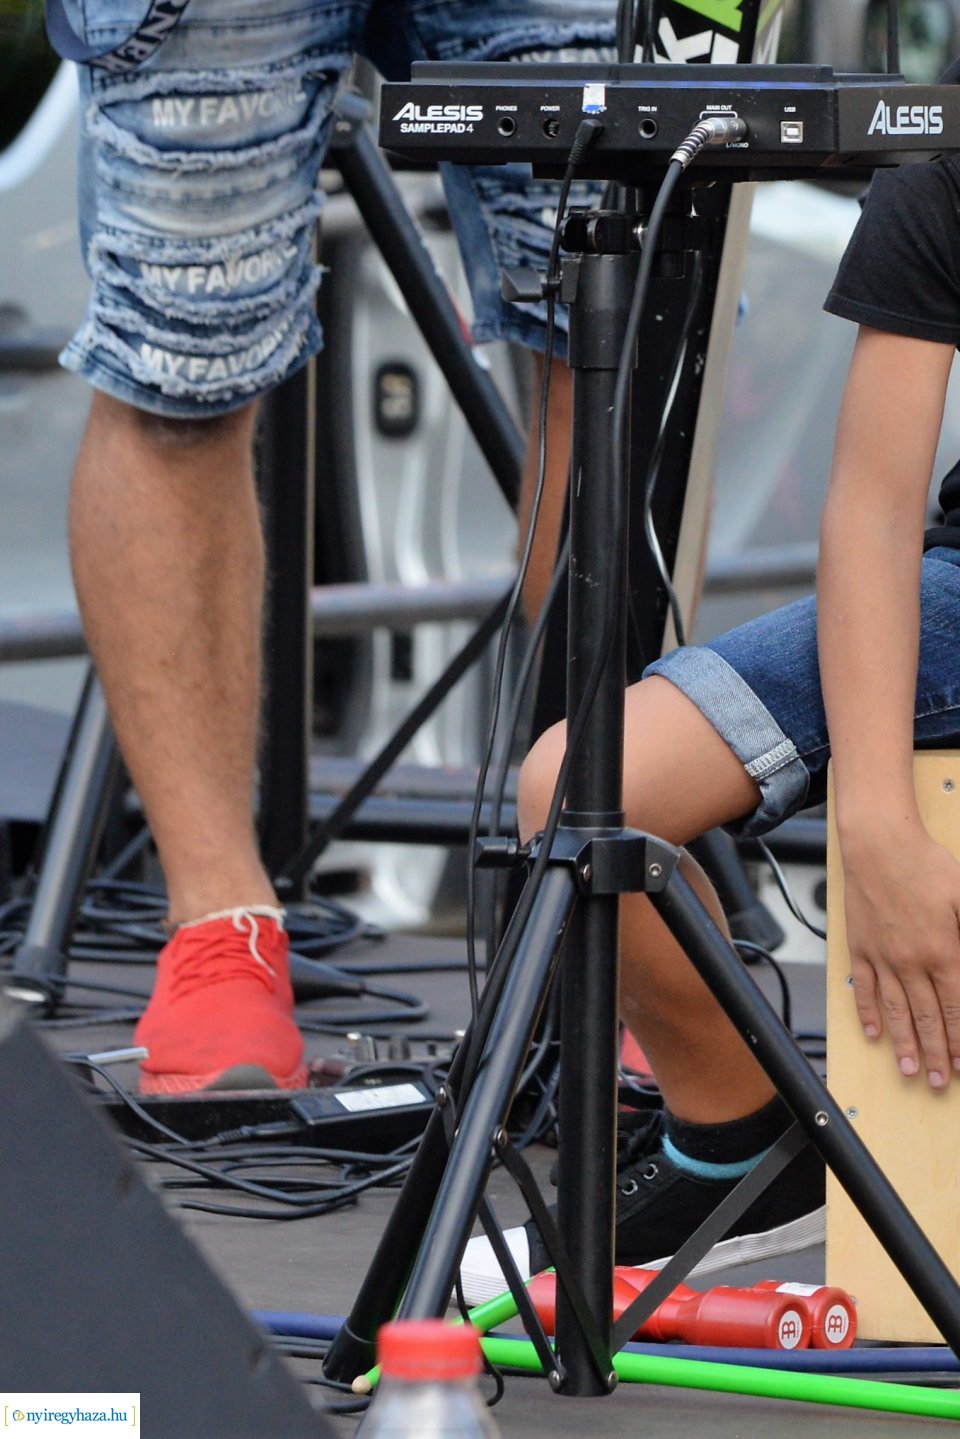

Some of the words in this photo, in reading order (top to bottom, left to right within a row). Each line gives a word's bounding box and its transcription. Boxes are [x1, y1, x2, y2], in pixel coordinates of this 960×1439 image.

[152, 98, 194, 127] MY
[392, 101, 484, 122] ALESIS
[867, 100, 943, 136] ALESIS
[400, 122, 466, 133] SAMPLEPAD
[466, 123, 474, 133] 4
